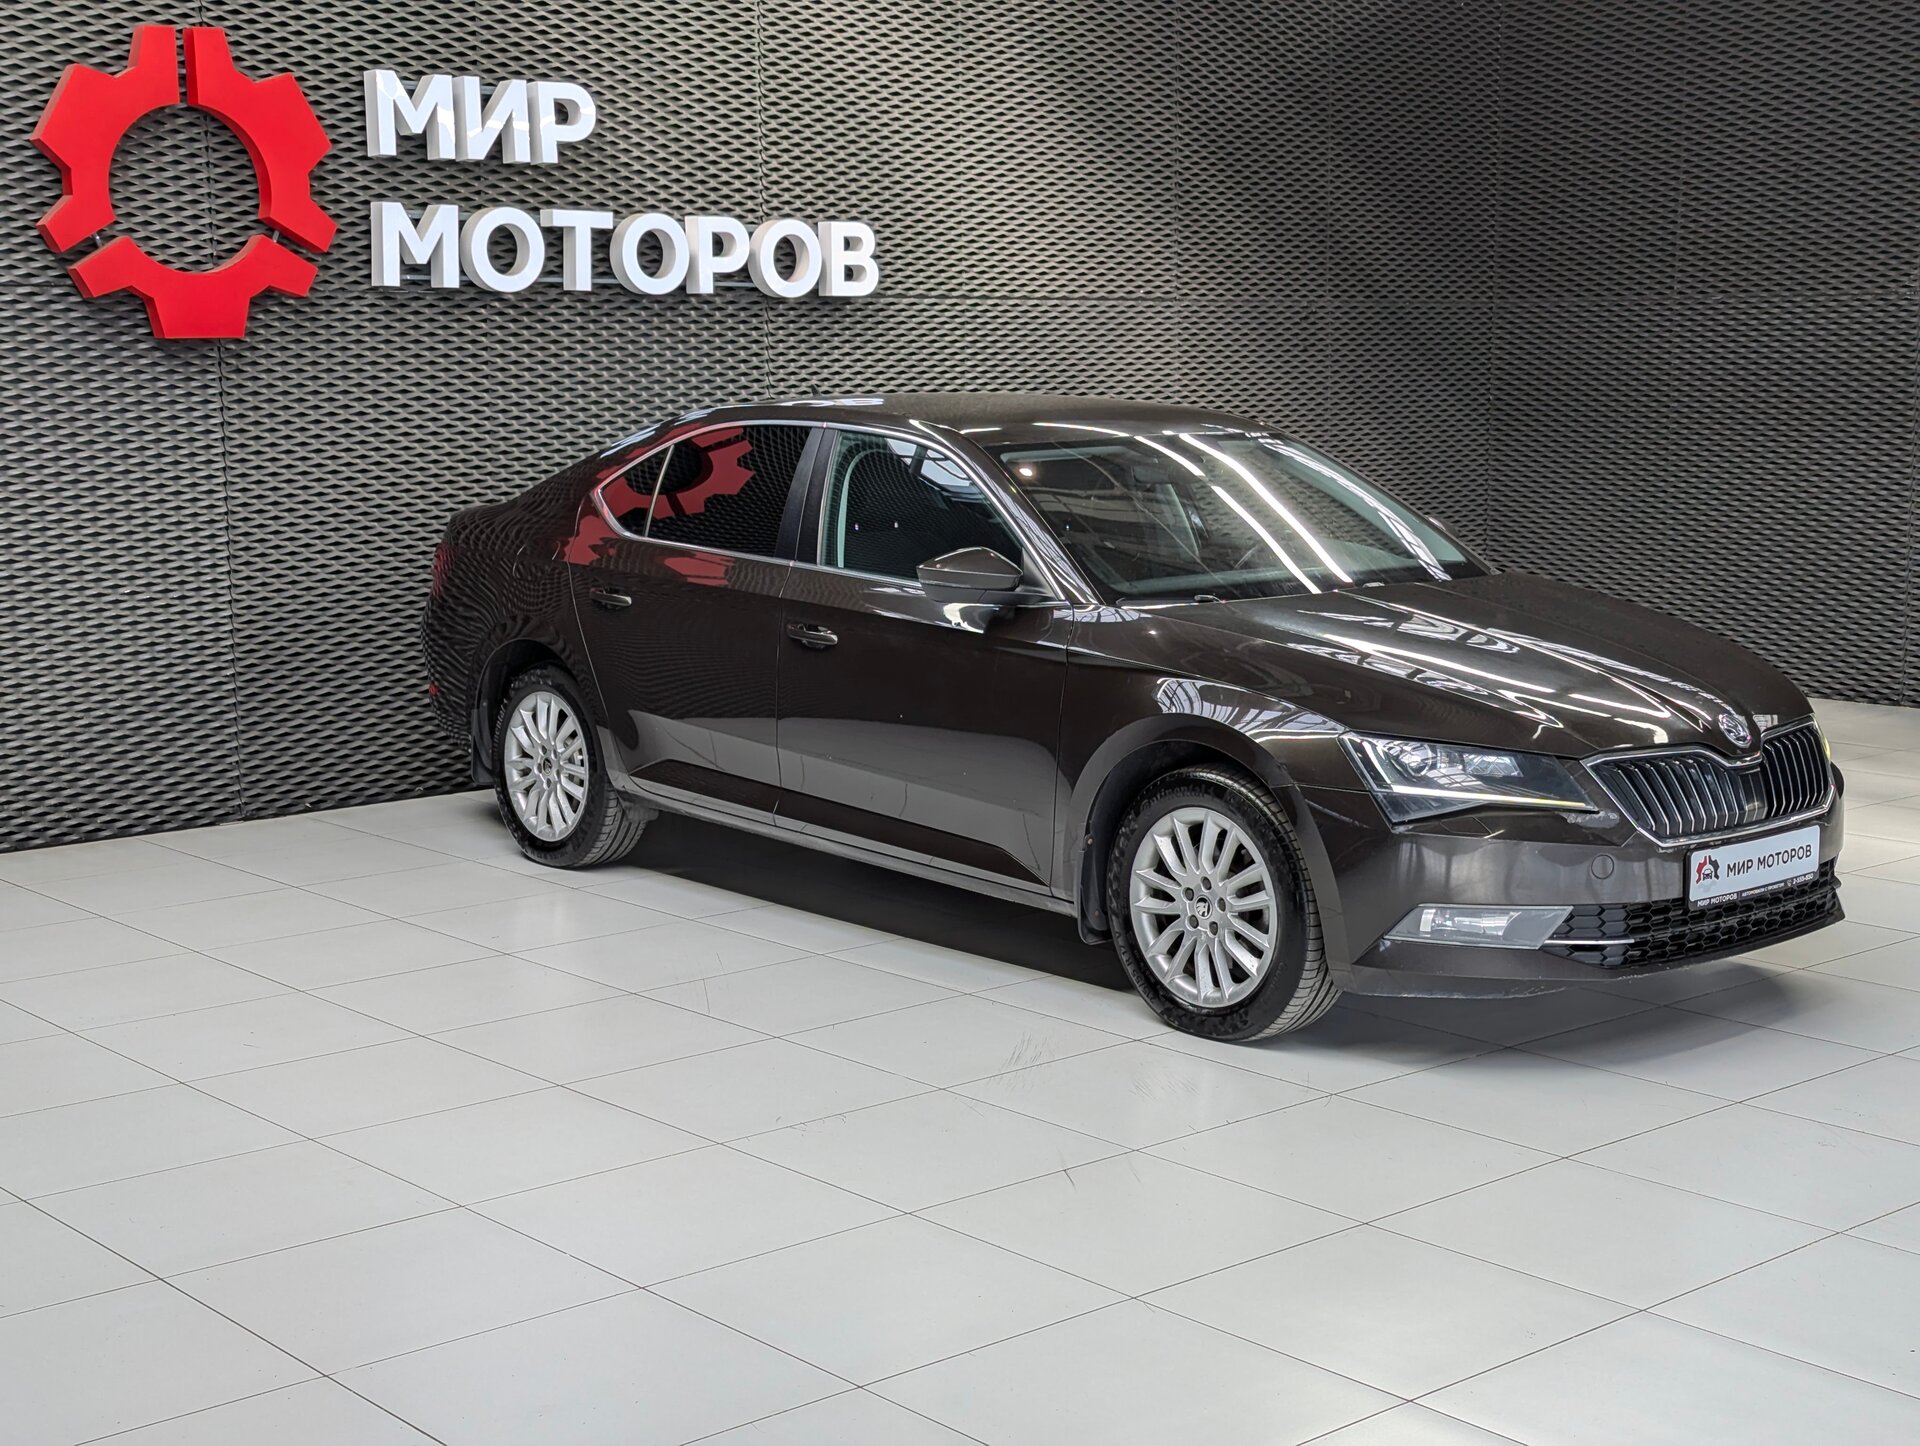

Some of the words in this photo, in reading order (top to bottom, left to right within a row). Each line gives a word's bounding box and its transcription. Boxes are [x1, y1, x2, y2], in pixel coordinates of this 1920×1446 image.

[363, 69, 596, 165] МИР
[370, 201, 879, 298] МОТОРОВ
[1726, 858, 1753, 878] МИР
[1757, 844, 1812, 870] МОТОРОВ
[1697, 898, 1710, 908] МИР
[1710, 893, 1738, 904] МОТОРОВ
